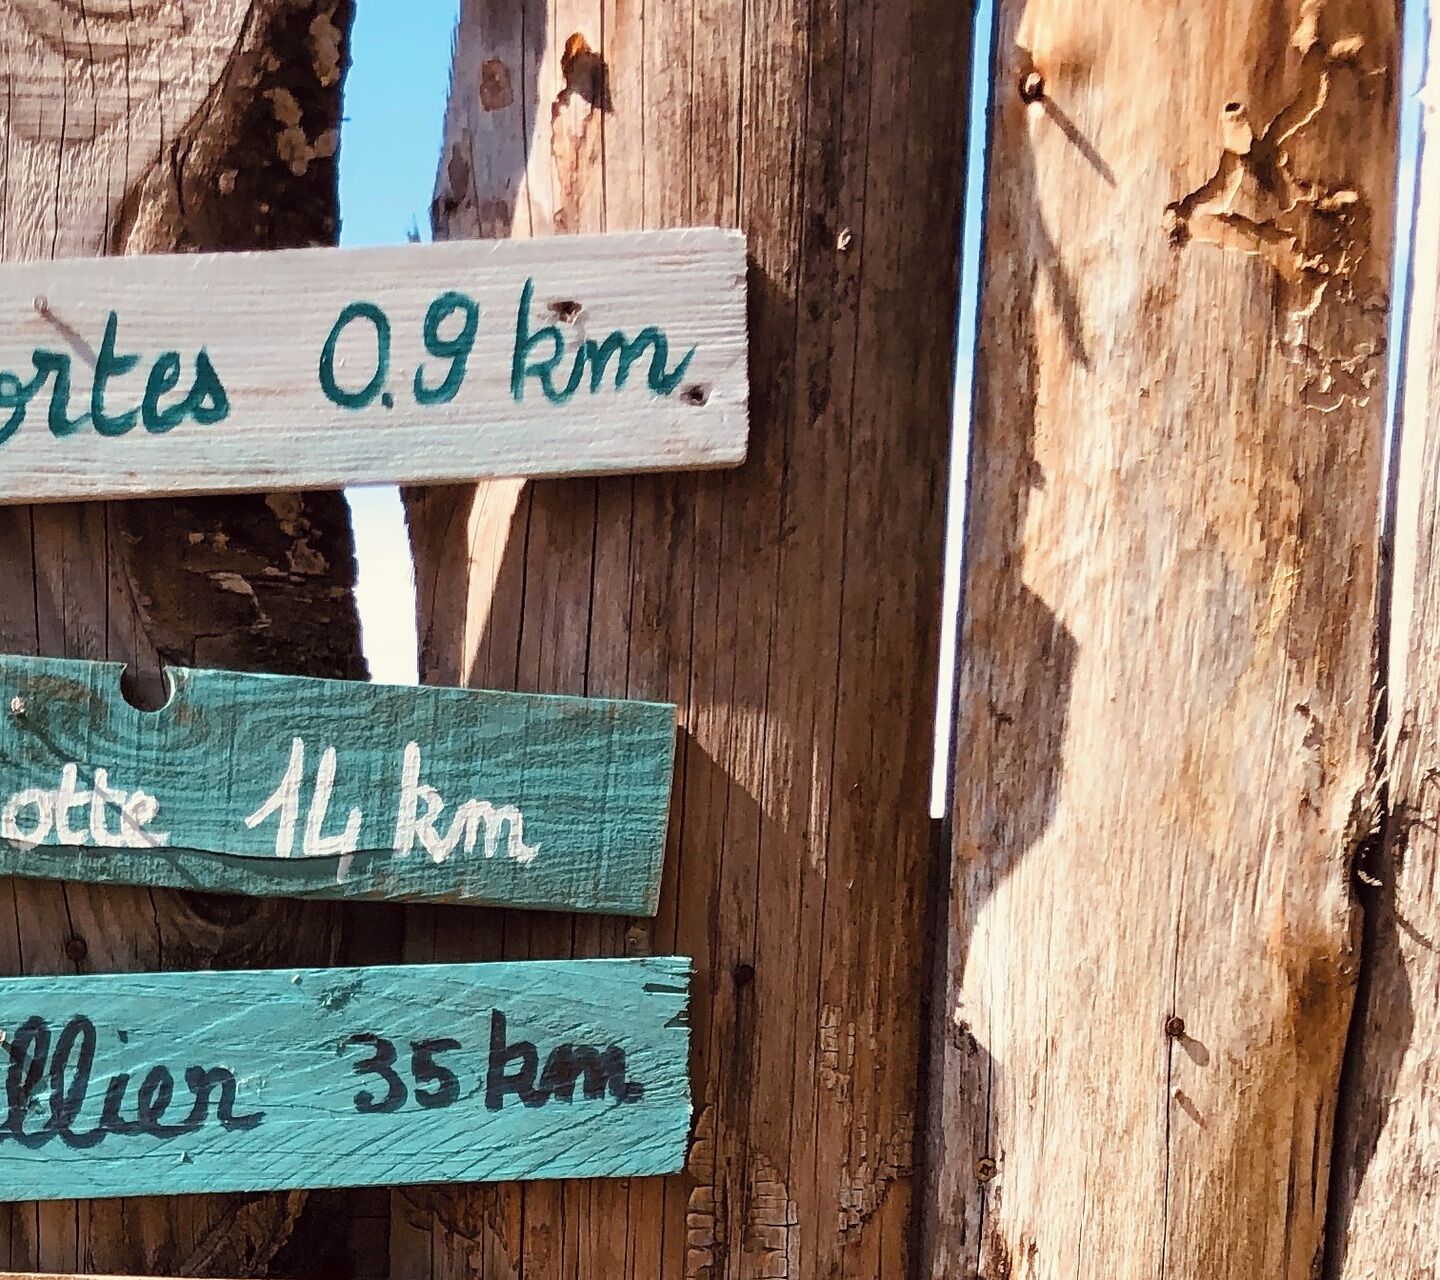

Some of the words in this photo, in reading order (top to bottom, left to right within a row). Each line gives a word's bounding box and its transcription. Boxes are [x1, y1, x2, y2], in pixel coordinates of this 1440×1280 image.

[319, 291, 480, 410] 0.9
[510, 276, 698, 406] km
[245, 737, 361, 883] 14
[393, 741, 541, 864] km
[336, 1032, 462, 1113] 35
[485, 1008, 645, 1111] km
